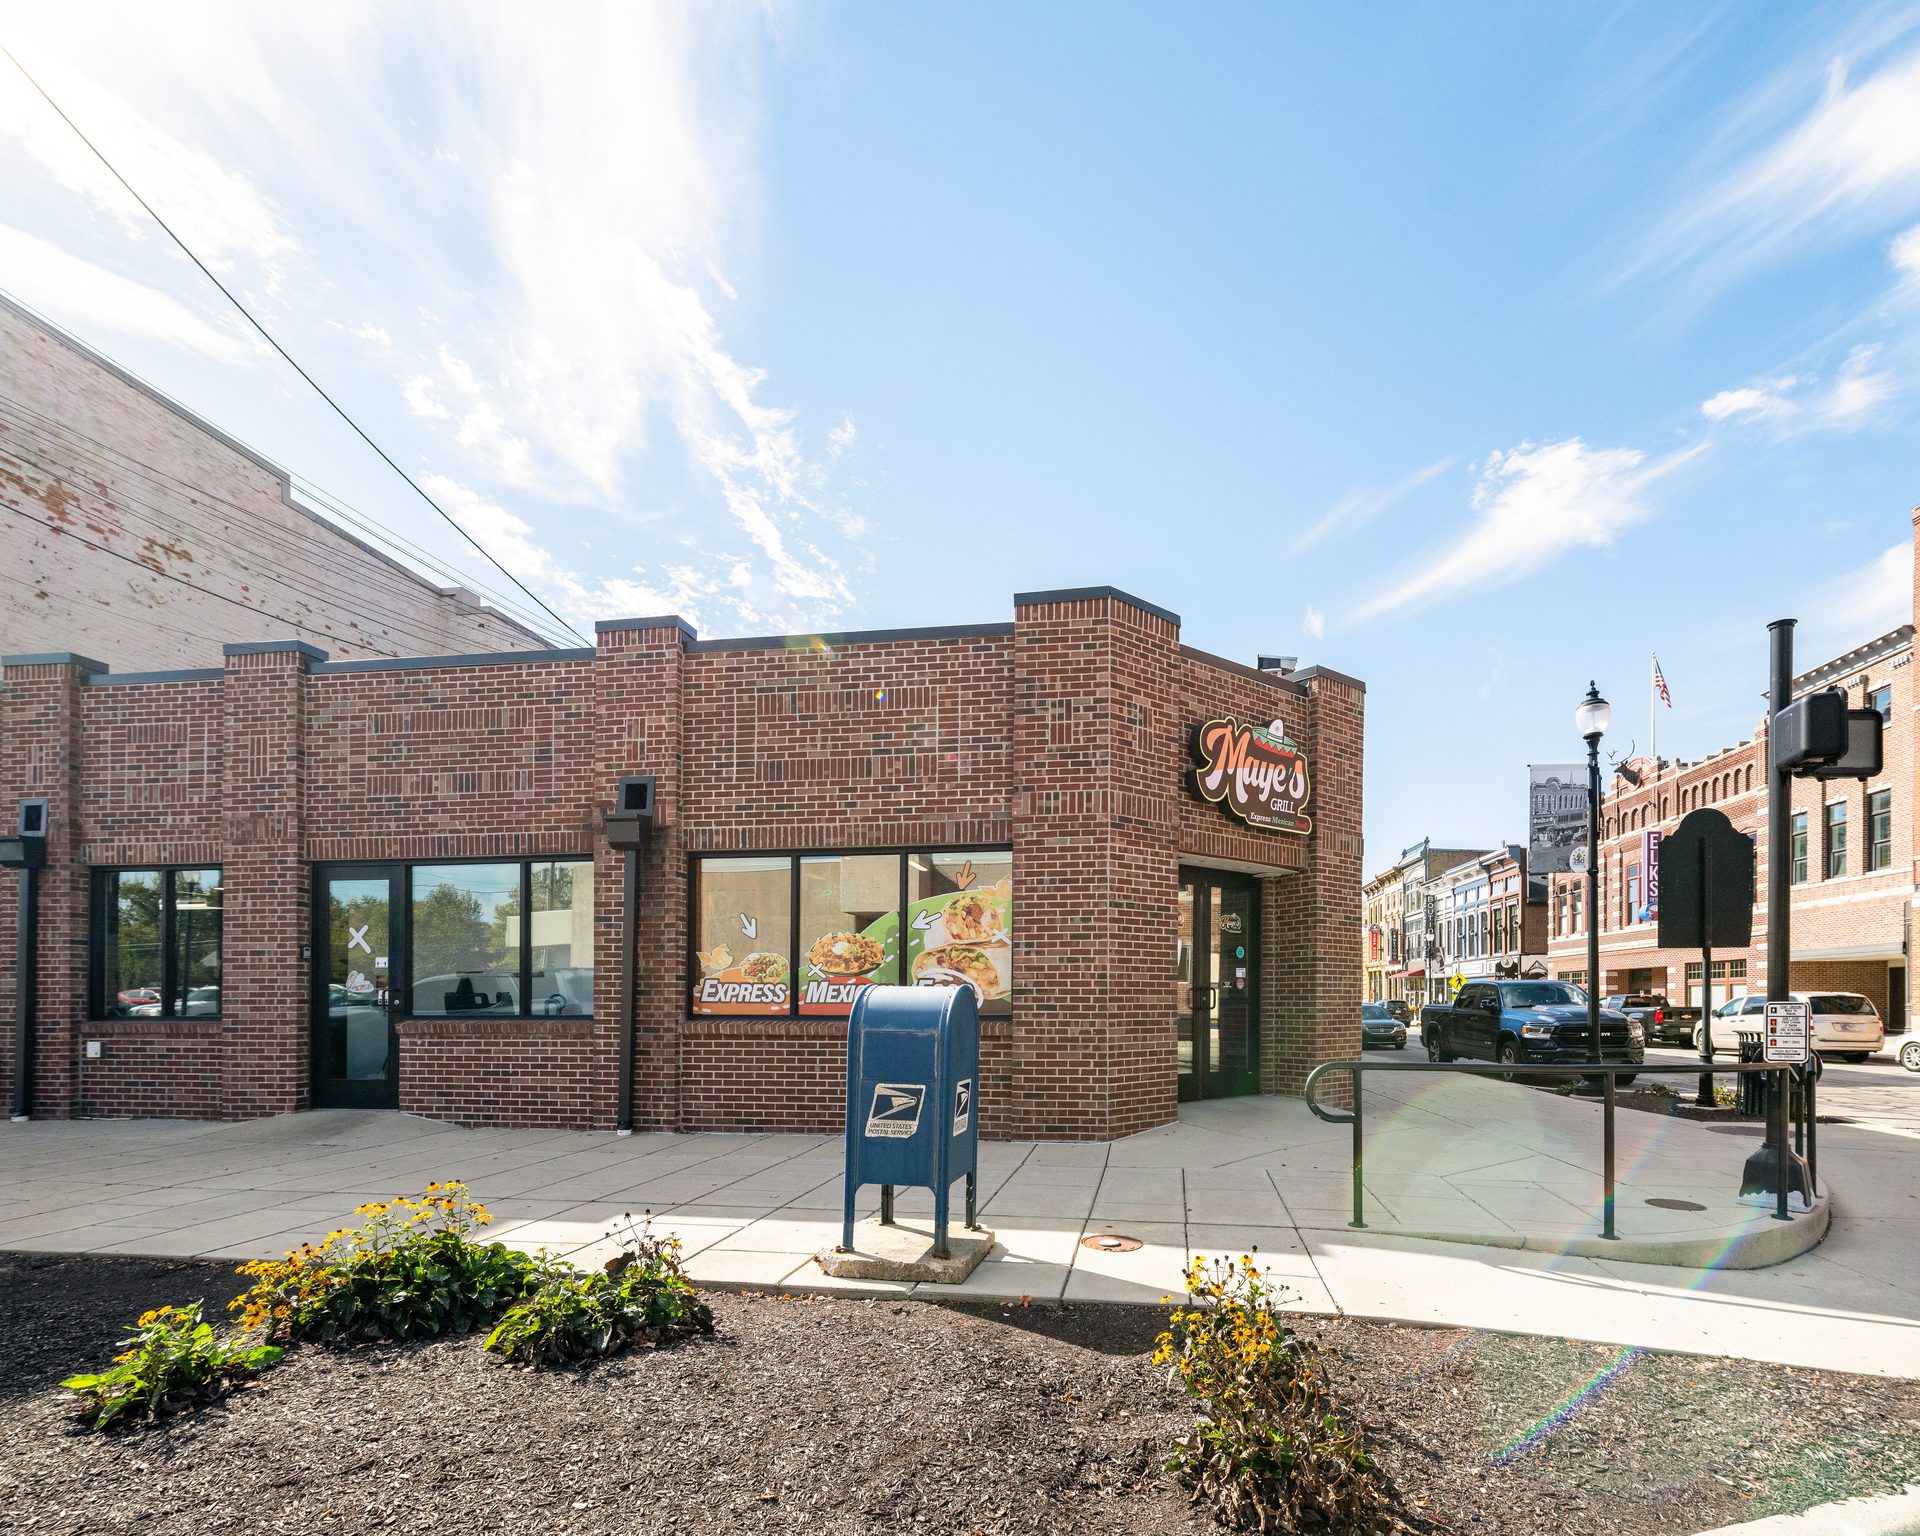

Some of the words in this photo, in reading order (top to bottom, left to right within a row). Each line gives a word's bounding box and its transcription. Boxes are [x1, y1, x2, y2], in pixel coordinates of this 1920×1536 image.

[1205, 724, 1305, 803] Maye's
[1270, 797, 1296, 814] GRILL
[1250, 811, 1272, 823] Express
[1271, 815, 1295, 827] Mexican
[1649, 833, 1659, 897] ELKS
[701, 979, 787, 1003] EXPRESS
